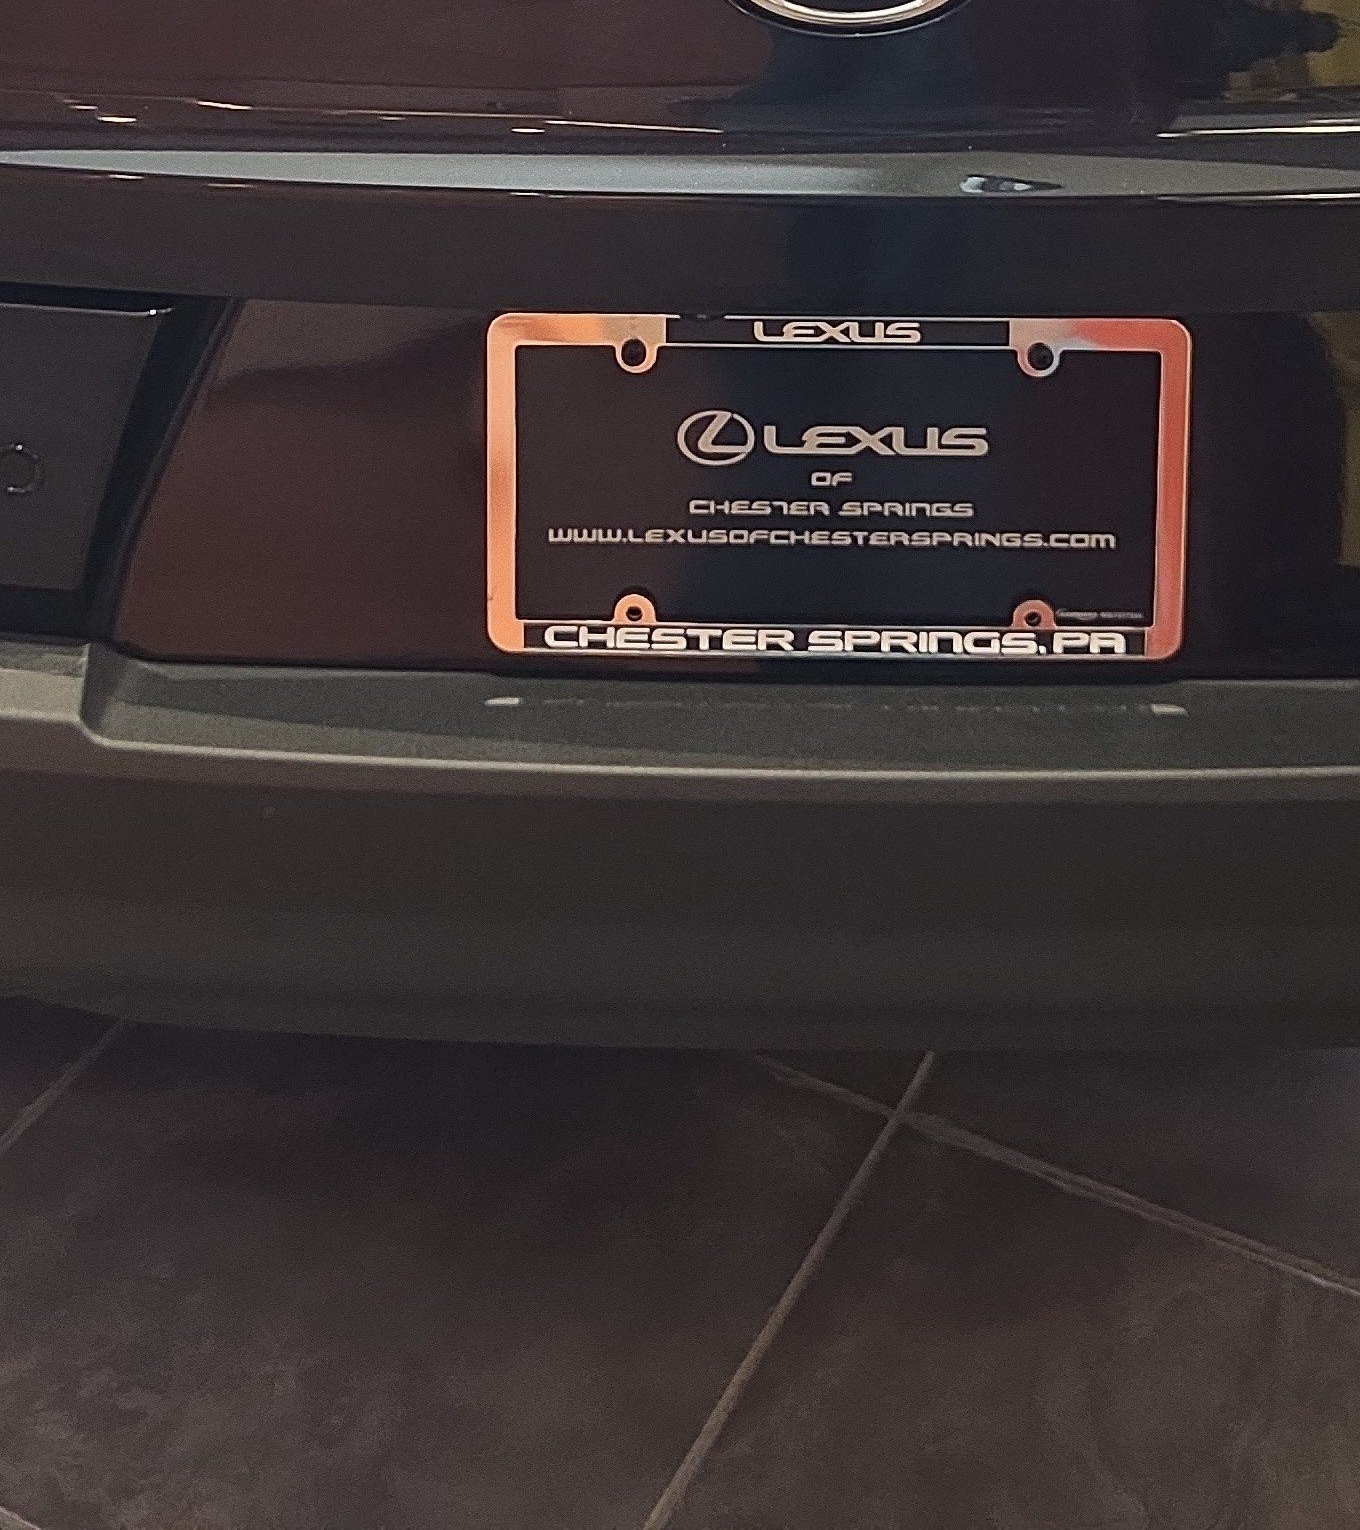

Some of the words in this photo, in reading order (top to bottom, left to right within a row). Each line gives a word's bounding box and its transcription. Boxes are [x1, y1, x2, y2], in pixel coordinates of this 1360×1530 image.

[753, 321, 922, 343] LEXUS
[763, 425, 989, 456] LEXUS
[810, 471, 853, 487] OF
[689, 499, 830, 516] CHESTER
[838, 501, 975, 518] SPRINGS
[543, 625, 795, 651] CHESTER
